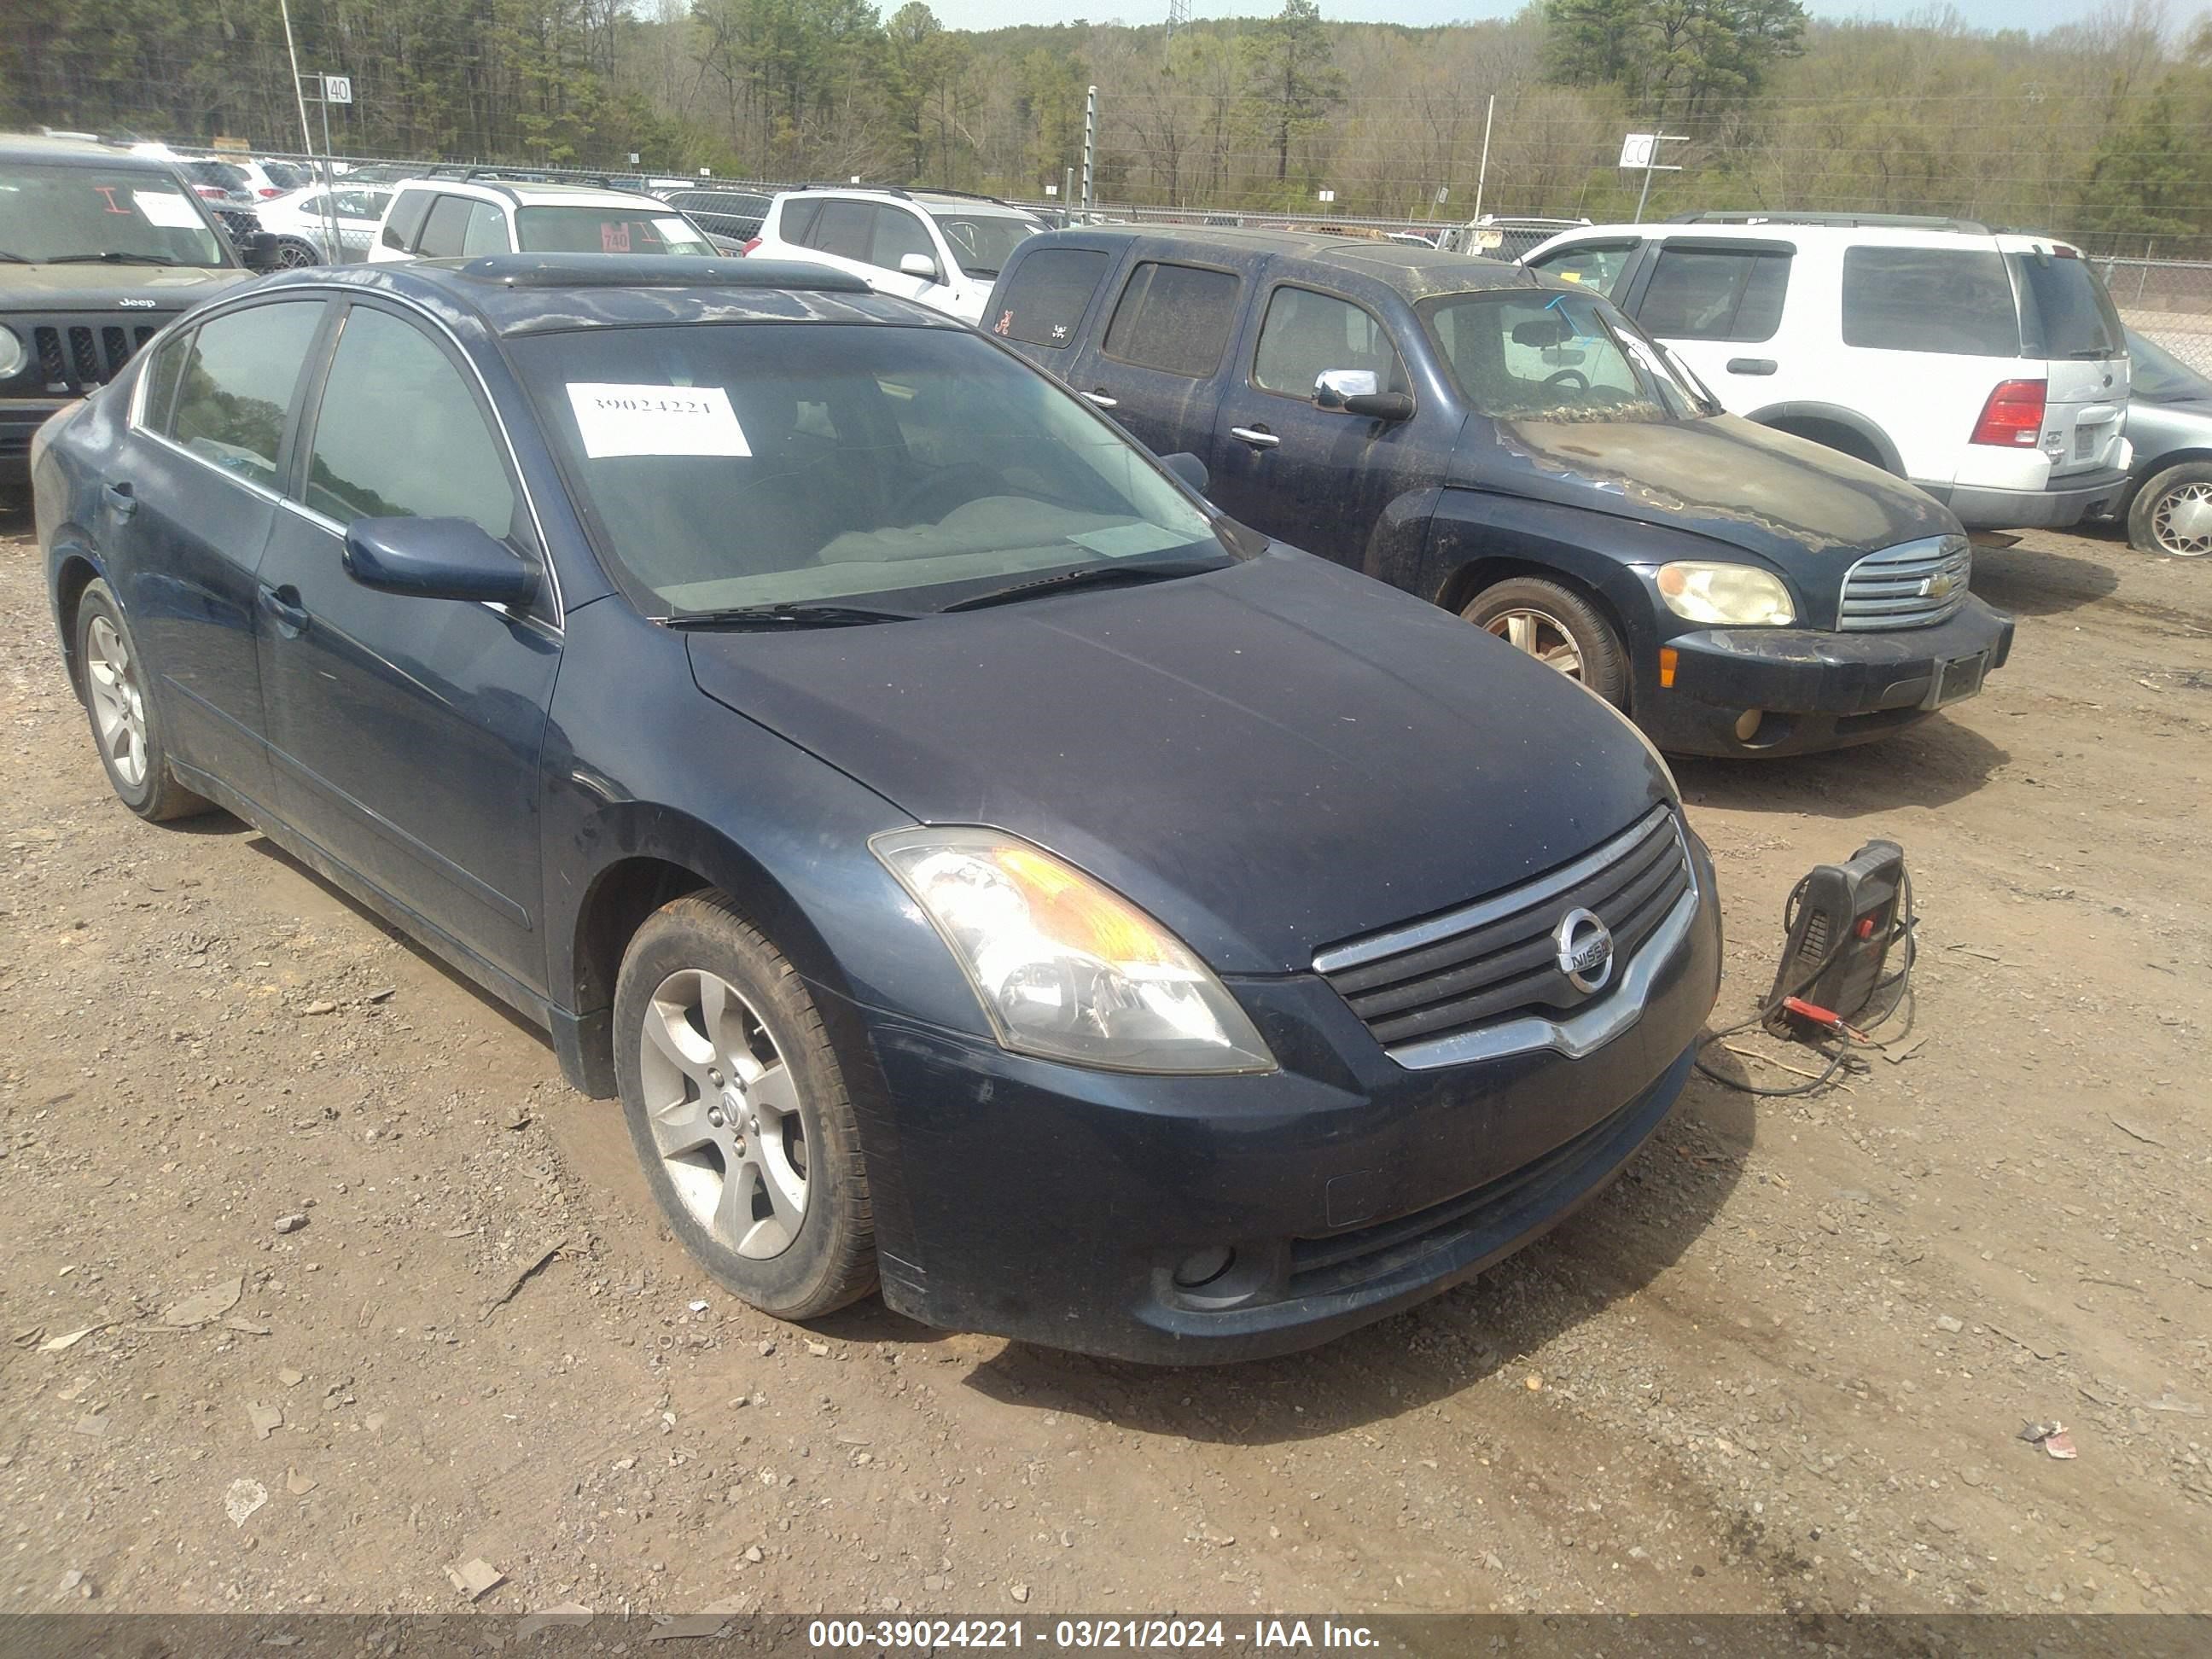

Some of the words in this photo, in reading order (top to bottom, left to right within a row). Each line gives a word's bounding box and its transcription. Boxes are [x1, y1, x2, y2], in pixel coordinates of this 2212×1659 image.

[330, 80, 348, 100] 40
[603, 234, 628, 247] 740
[119, 298, 156, 308] Jeep
[1571, 940, 1611, 969] NISSA
